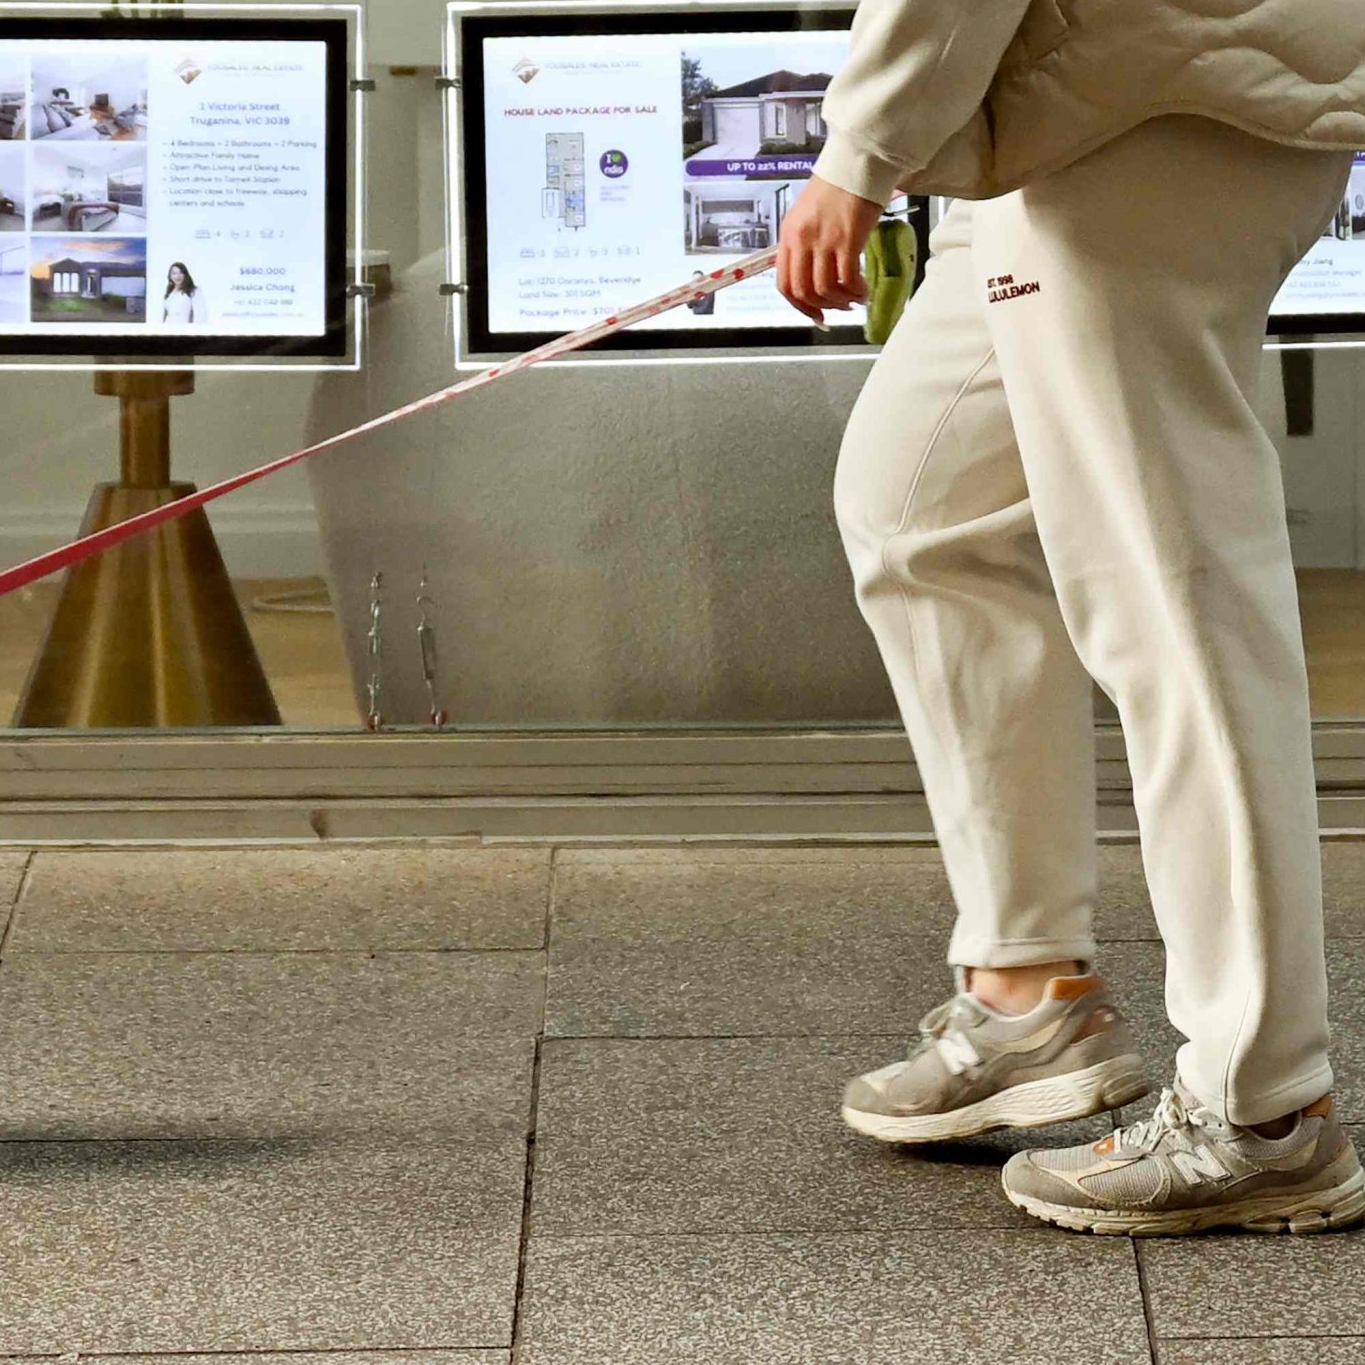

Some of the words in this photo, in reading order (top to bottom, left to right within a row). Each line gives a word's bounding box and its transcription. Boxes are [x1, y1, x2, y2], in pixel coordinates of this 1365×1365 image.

[209, 103, 247, 111] Victoria
[504, 109, 535, 117] HOUSE
[538, 108, 563, 116] LAND
[566, 107, 610, 115] PACKAGE
[636, 106, 657, 114] SALE
[191, 118, 242, 126] Truganina,
[245, 117, 261, 125] VIC
[604, 165, 623, 174] ndis
[727, 163, 741, 172] UP
[743, 162, 756, 171] TO
[778, 161, 813, 171] RENTAL
[997, 274, 1014, 285] 1998
[266, 284, 295, 293] Chong
[988, 281, 1040, 302] LULULEMON
[1171, 1144, 1232, 1185] N
